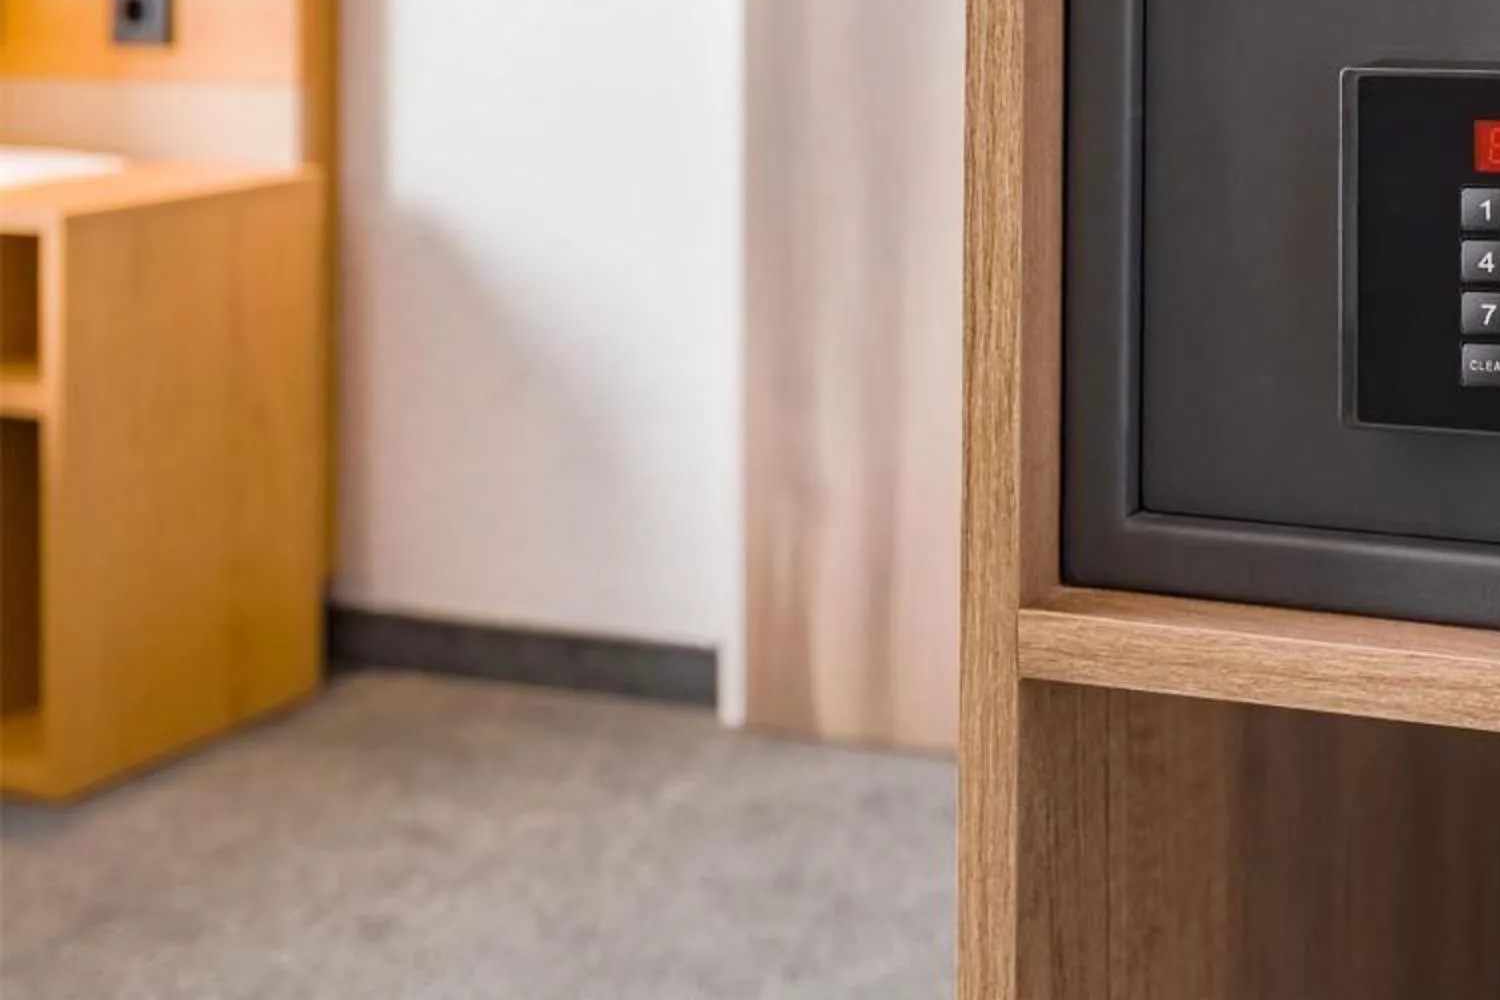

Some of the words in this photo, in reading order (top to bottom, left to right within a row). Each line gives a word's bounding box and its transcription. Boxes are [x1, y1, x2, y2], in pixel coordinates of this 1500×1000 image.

[1479, 199, 1492, 220] 1
[1478, 252, 1494, 274] 4
[1480, 304, 1496, 326] 7
